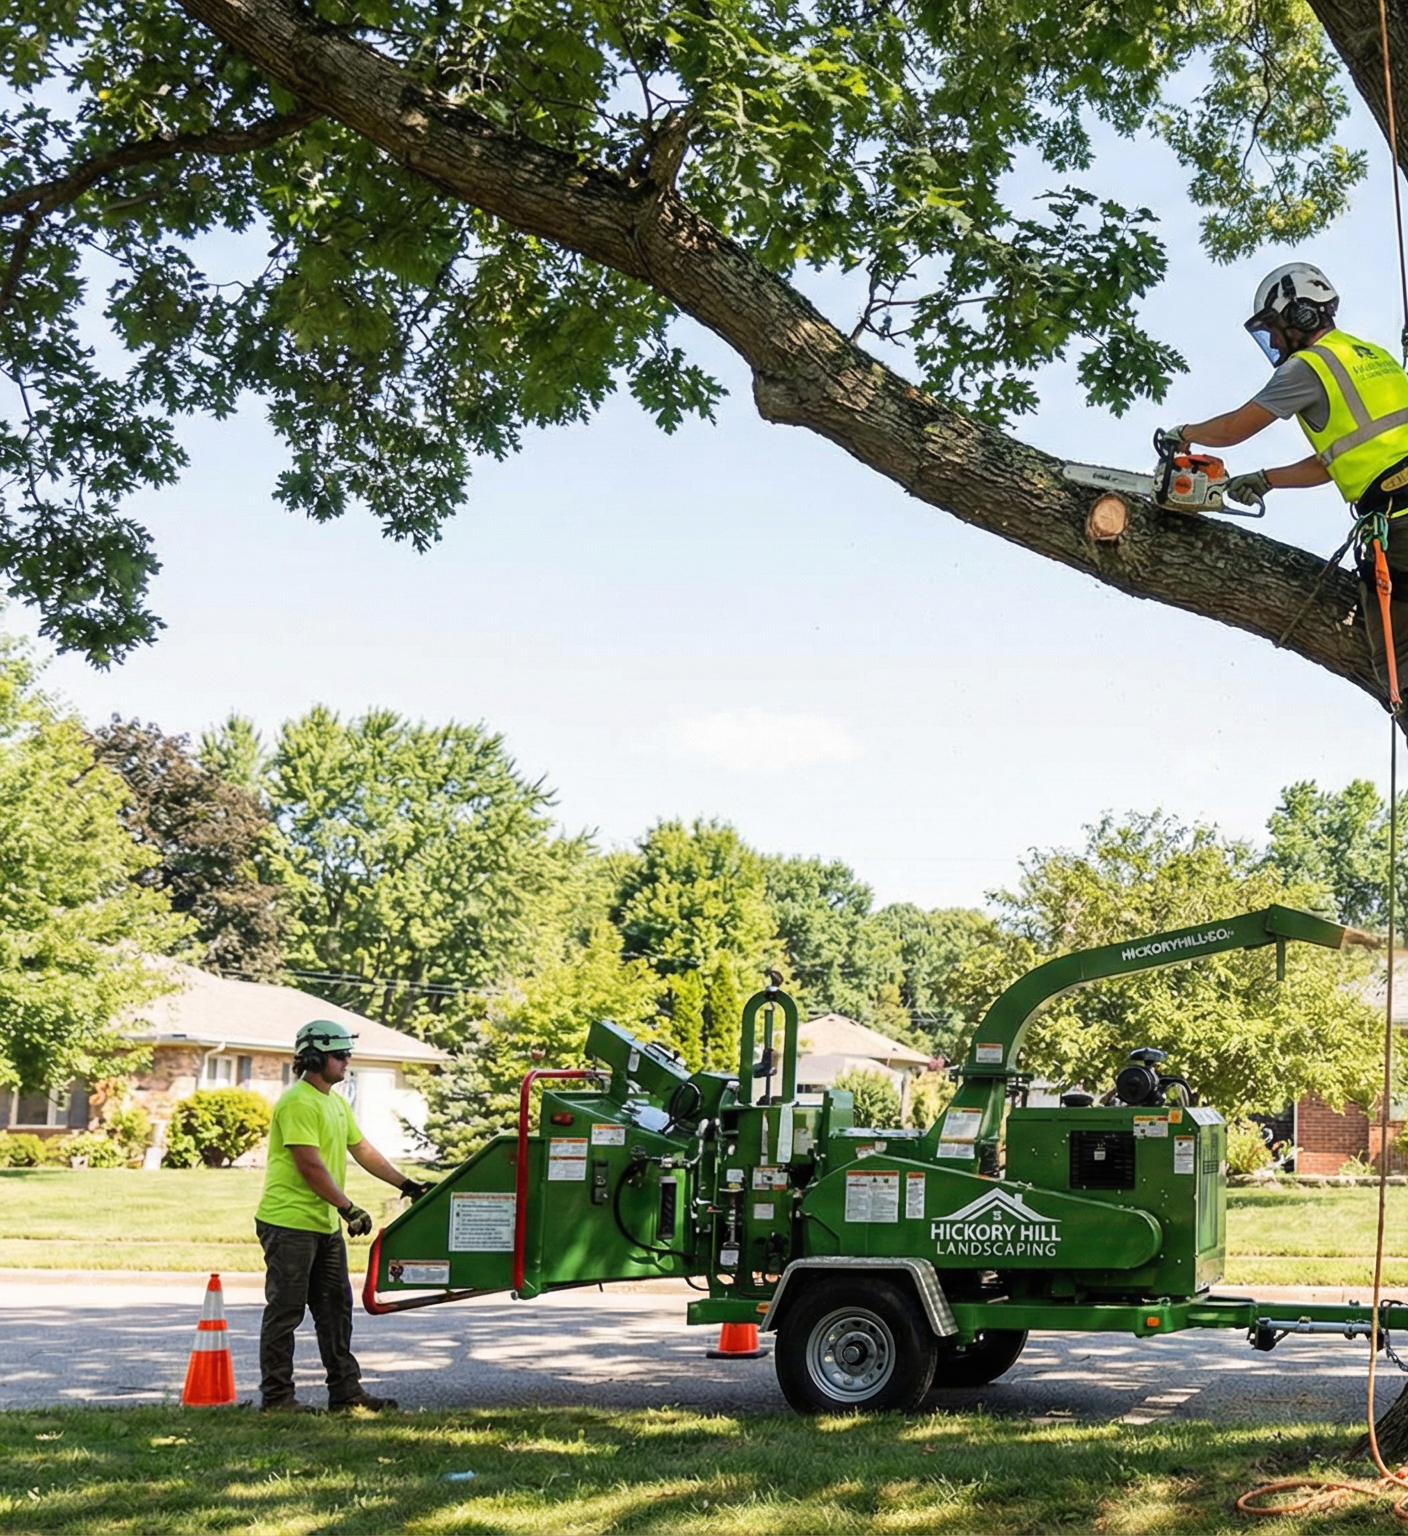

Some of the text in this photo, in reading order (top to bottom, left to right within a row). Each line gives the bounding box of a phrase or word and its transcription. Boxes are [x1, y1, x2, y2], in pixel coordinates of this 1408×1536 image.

[930, 1223, 1062, 1241] HICKORY HILL
[937, 1241, 1057, 1257] LANDSCAPING
